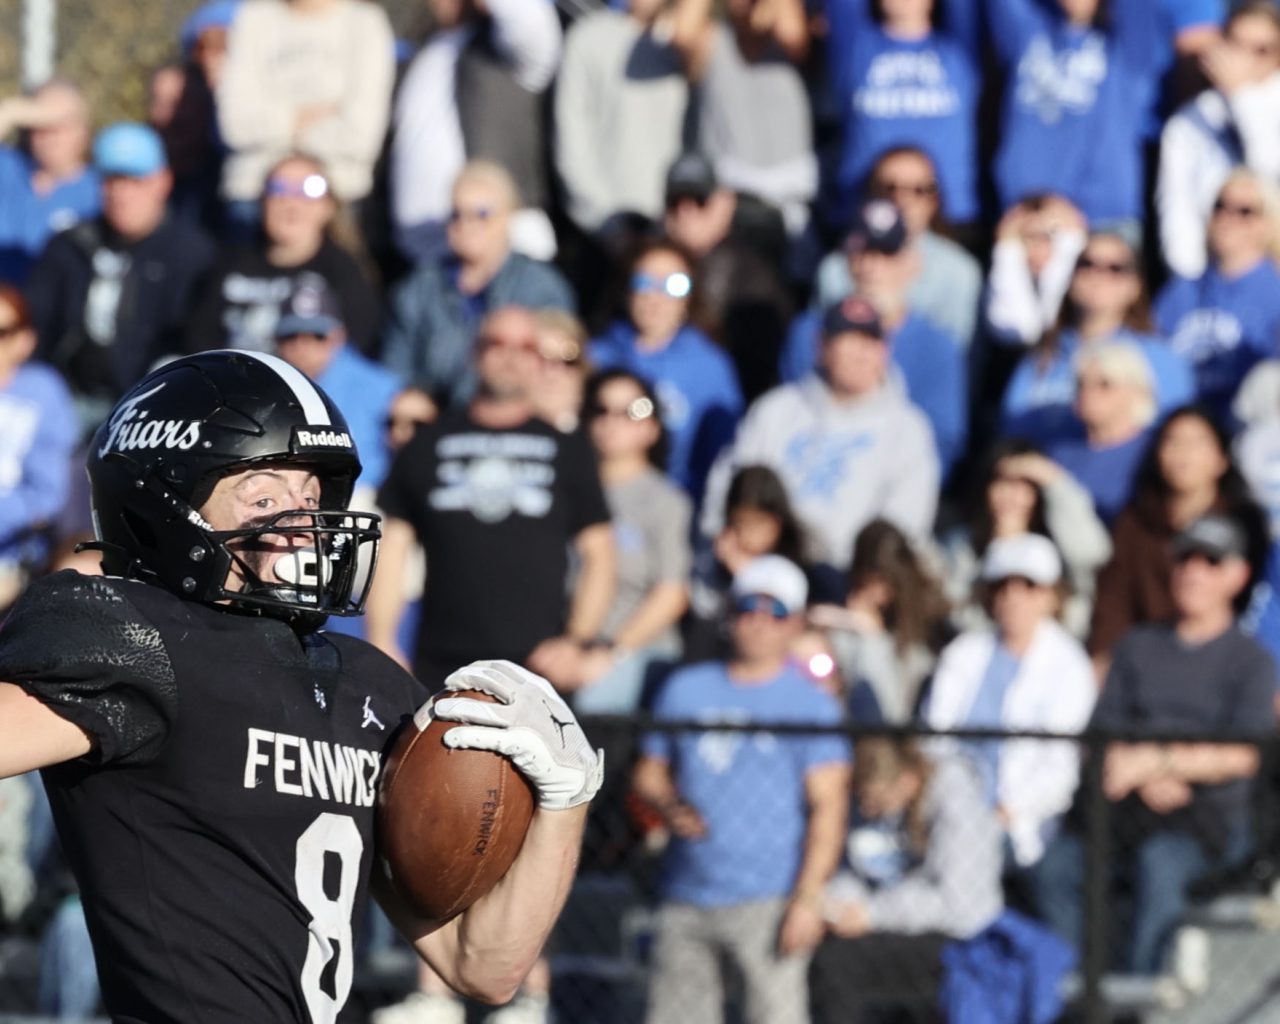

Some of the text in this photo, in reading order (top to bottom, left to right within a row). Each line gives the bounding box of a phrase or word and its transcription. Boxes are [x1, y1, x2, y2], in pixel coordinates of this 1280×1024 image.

[98, 382, 202, 459] Friars
[297, 430, 352, 448] Riddell
[472, 789, 497, 857] FENWICK
